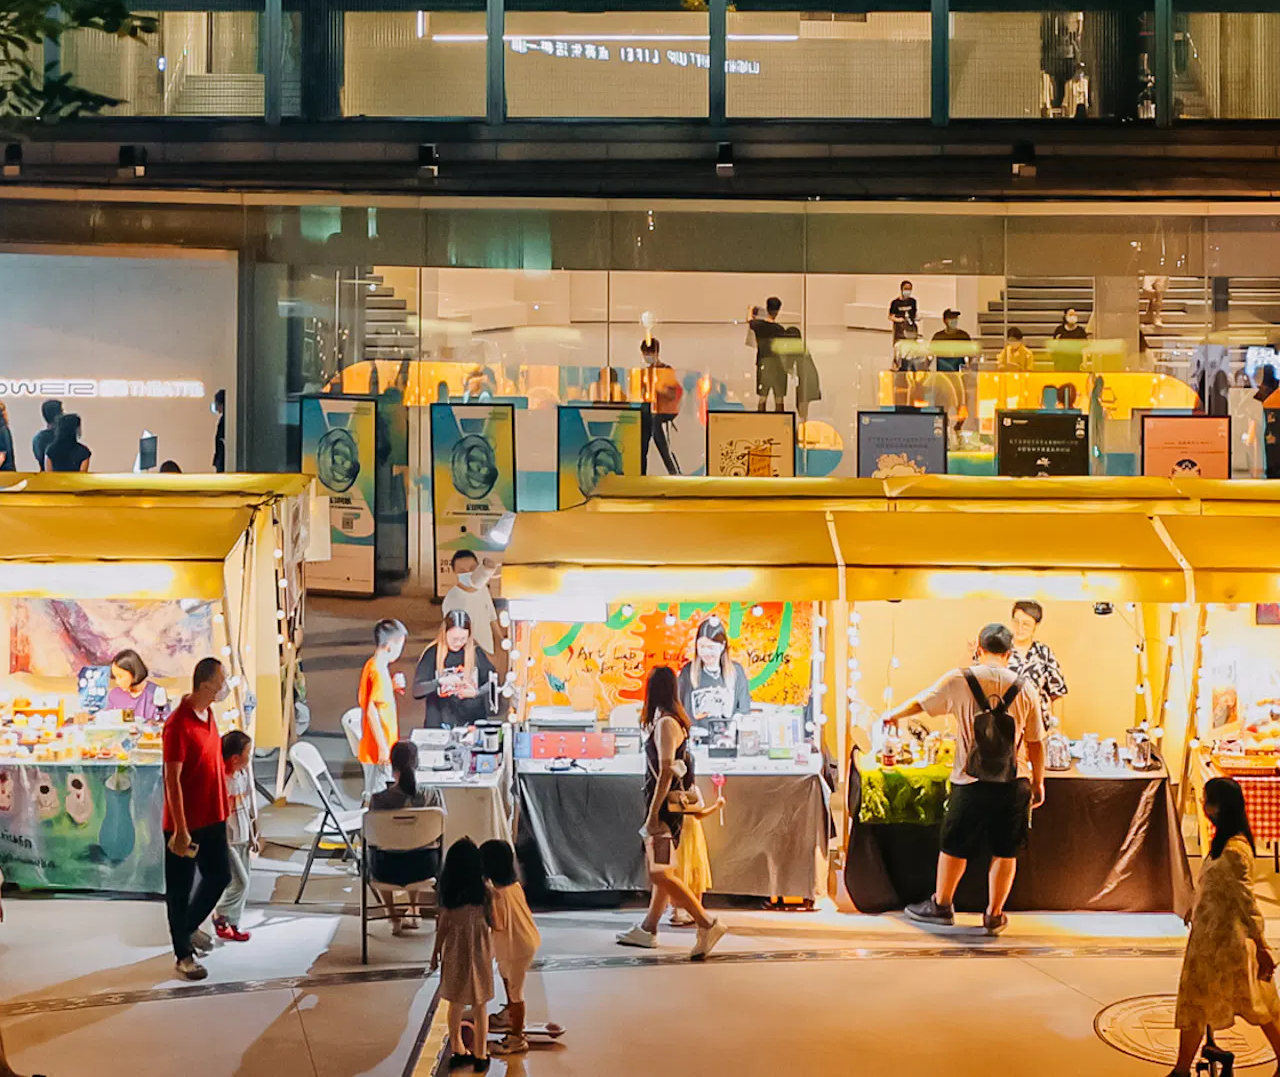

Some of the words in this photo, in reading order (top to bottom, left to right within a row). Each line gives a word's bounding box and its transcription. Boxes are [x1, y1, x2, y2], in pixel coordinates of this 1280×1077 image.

[577, 646, 604, 661] Art
[613, 646, 637, 661] Lab
[746, 647, 790, 665] Youths
